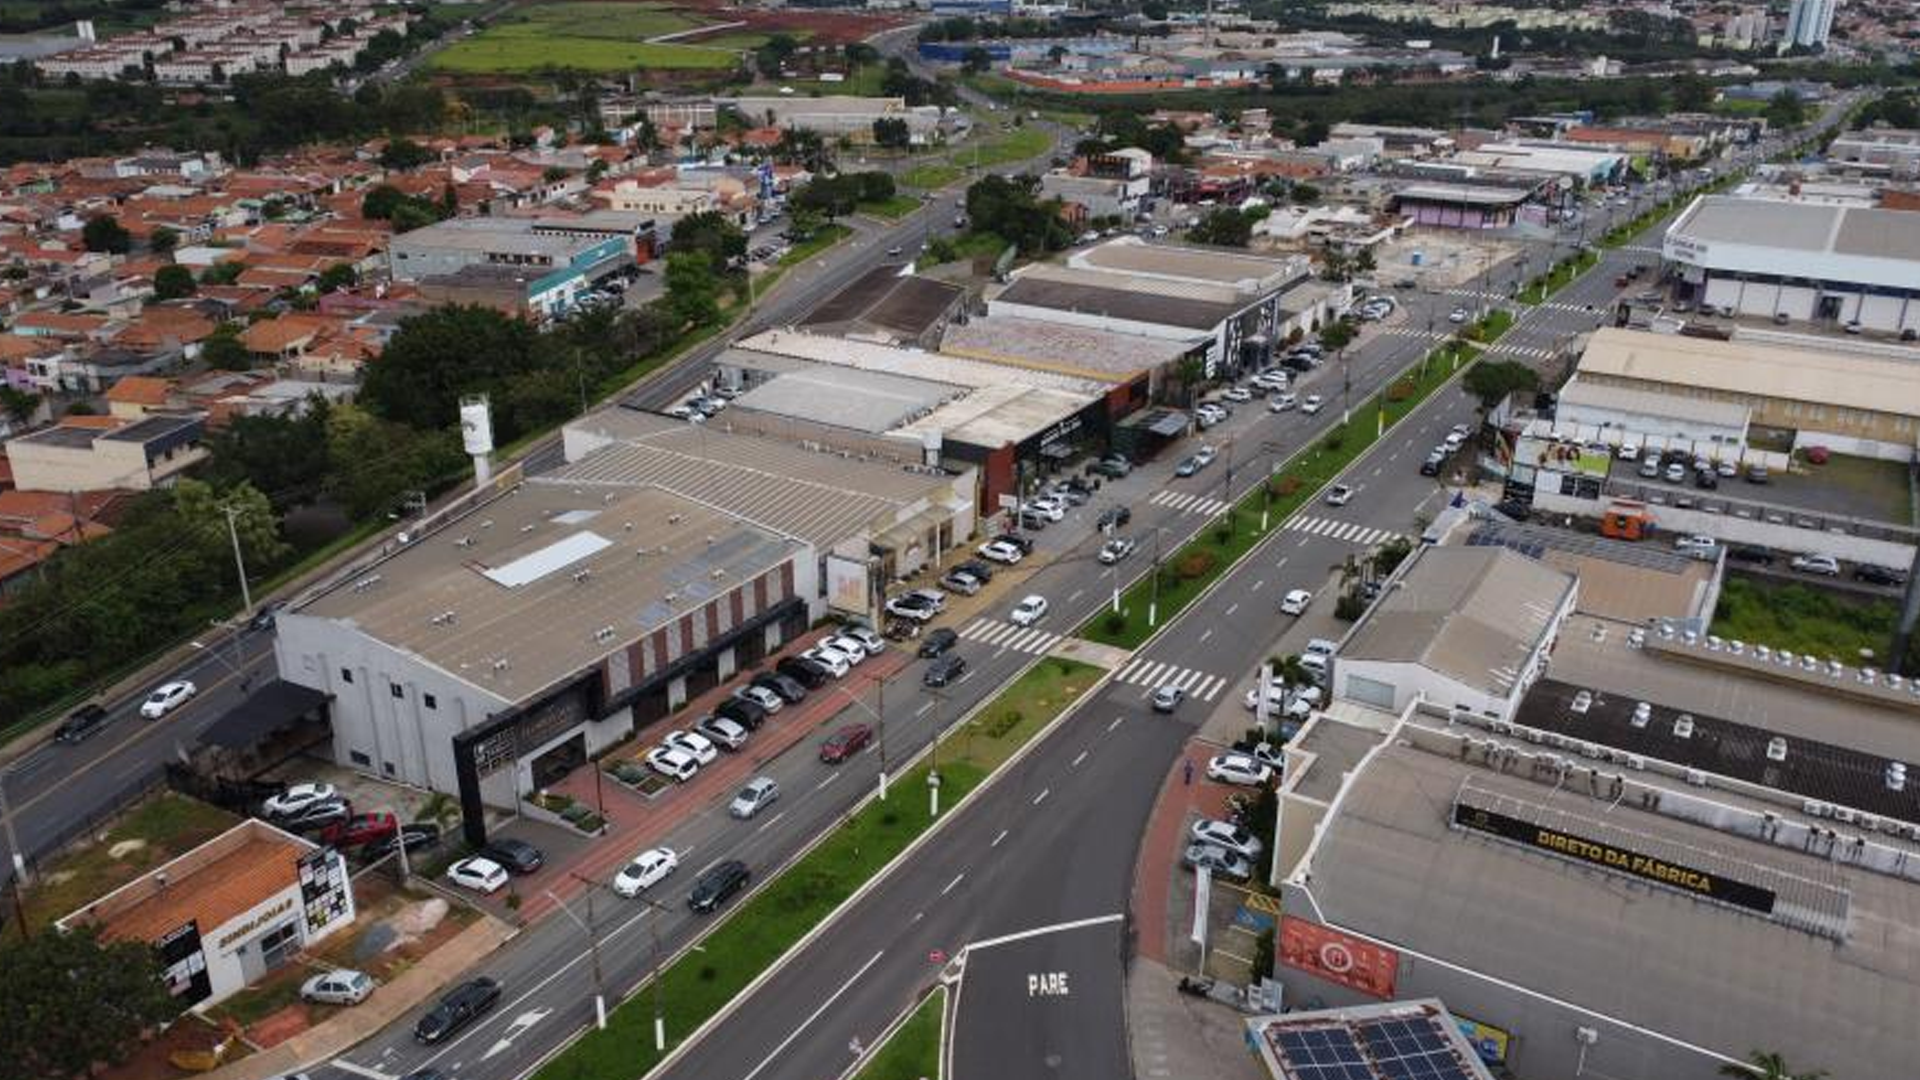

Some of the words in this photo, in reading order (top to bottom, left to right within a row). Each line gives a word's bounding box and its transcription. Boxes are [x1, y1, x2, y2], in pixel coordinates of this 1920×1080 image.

[1538, 831, 1601, 859] DIRETO
[1605, 849, 1628, 868] DA
[1632, 857, 1711, 892] FÁBRICA
[1029, 972, 1069, 996] PARE
